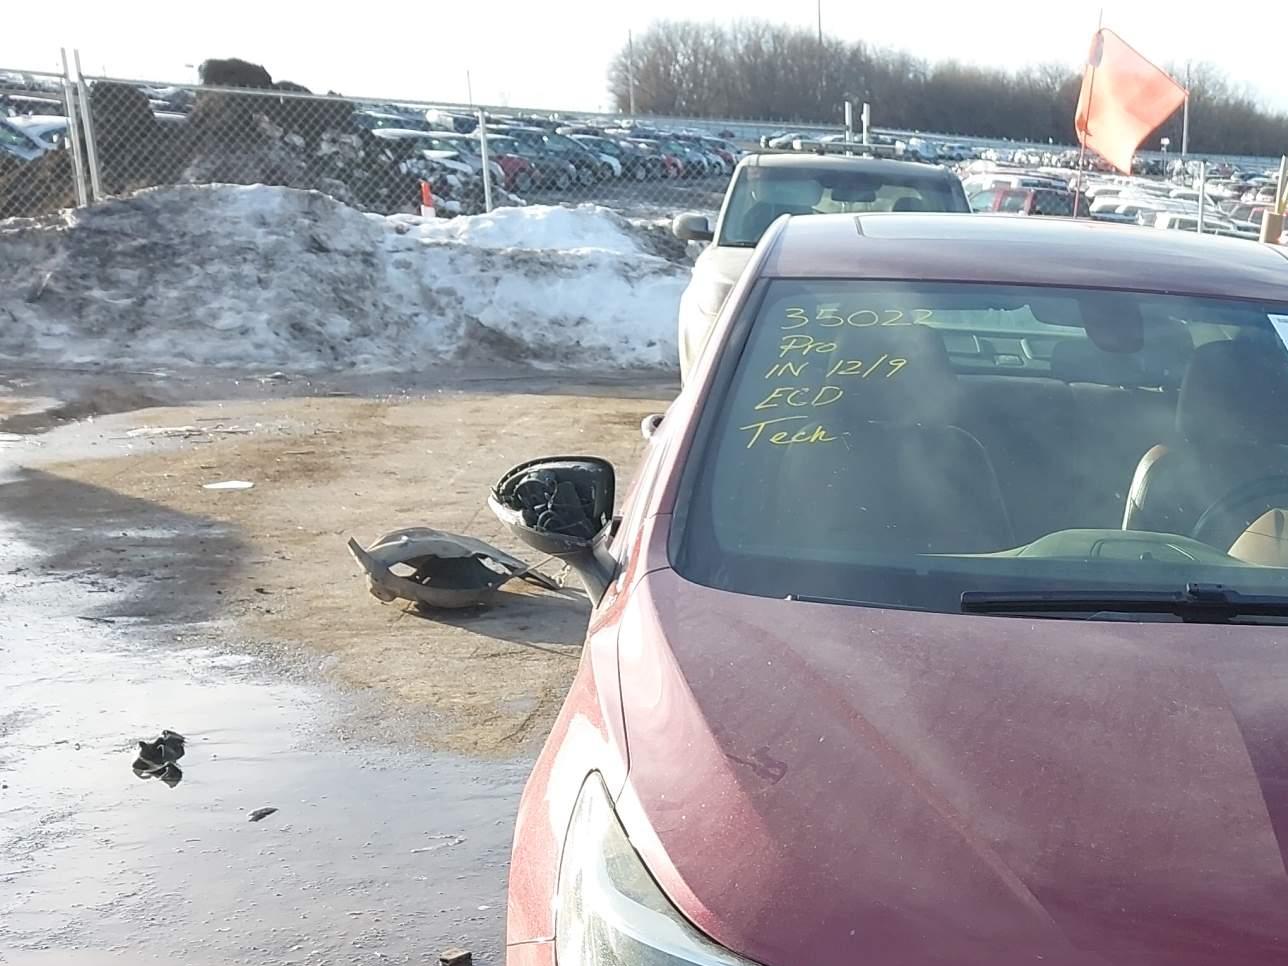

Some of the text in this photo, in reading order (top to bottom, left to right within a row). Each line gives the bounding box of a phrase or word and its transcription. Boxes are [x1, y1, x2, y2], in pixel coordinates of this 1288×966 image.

[765, 353, 908, 379] IN 12/9
[754, 386, 844, 410] ECD
